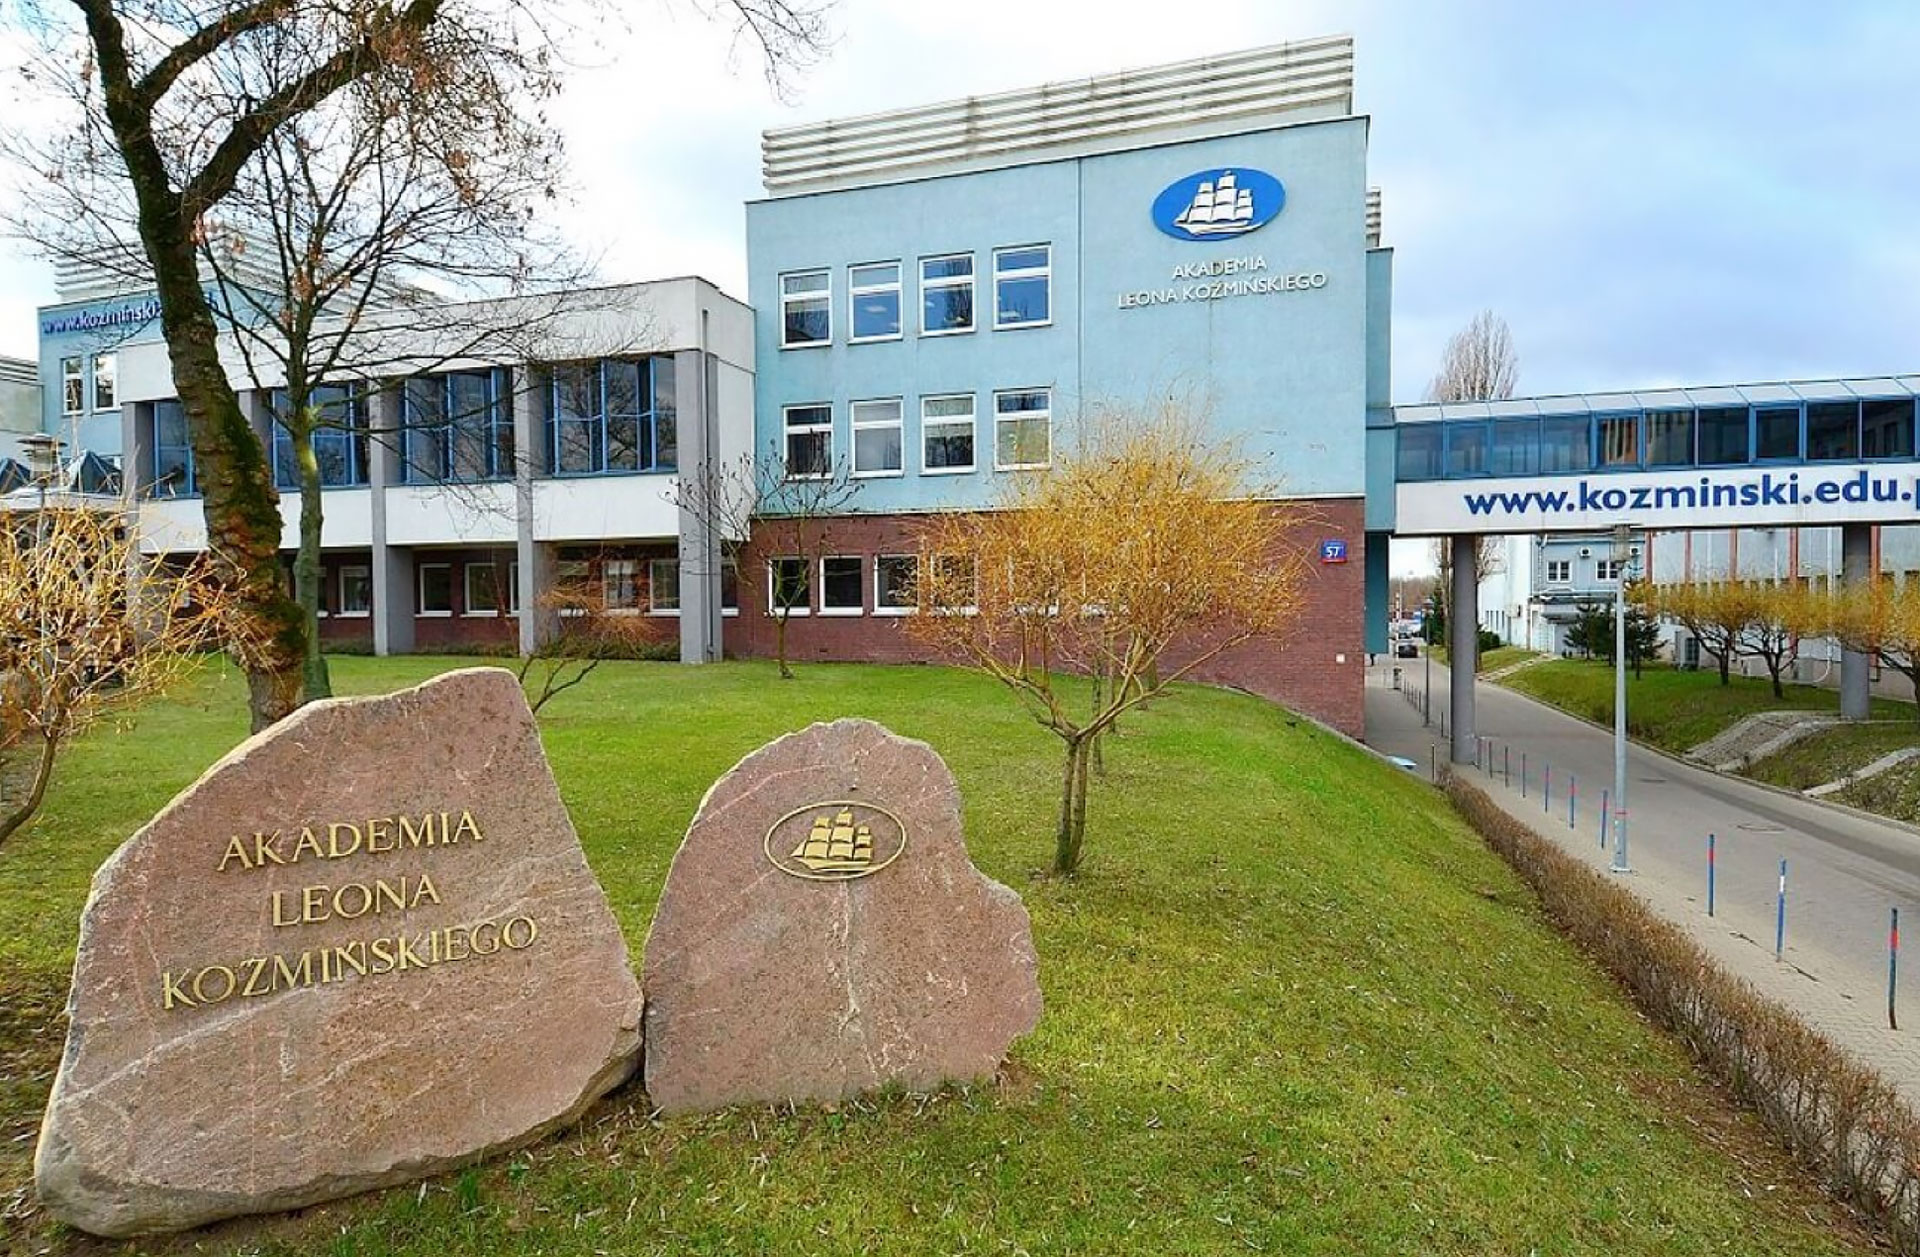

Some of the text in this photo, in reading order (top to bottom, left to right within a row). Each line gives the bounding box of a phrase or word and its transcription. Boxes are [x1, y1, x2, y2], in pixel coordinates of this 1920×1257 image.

[1118, 271, 1327, 309] LEONA KOŹMIŃSKIEGO
[1172, 255, 1267, 280] AKADEMIA
[1464, 470, 1920, 516] www.kozminski.edu.
[1326, 546, 1340, 558] 57
[216, 811, 484, 873] AKADEMIA
[272, 874, 442, 928] LEONA
[162, 916, 539, 1010] KOŹMIŃSKIEGO
